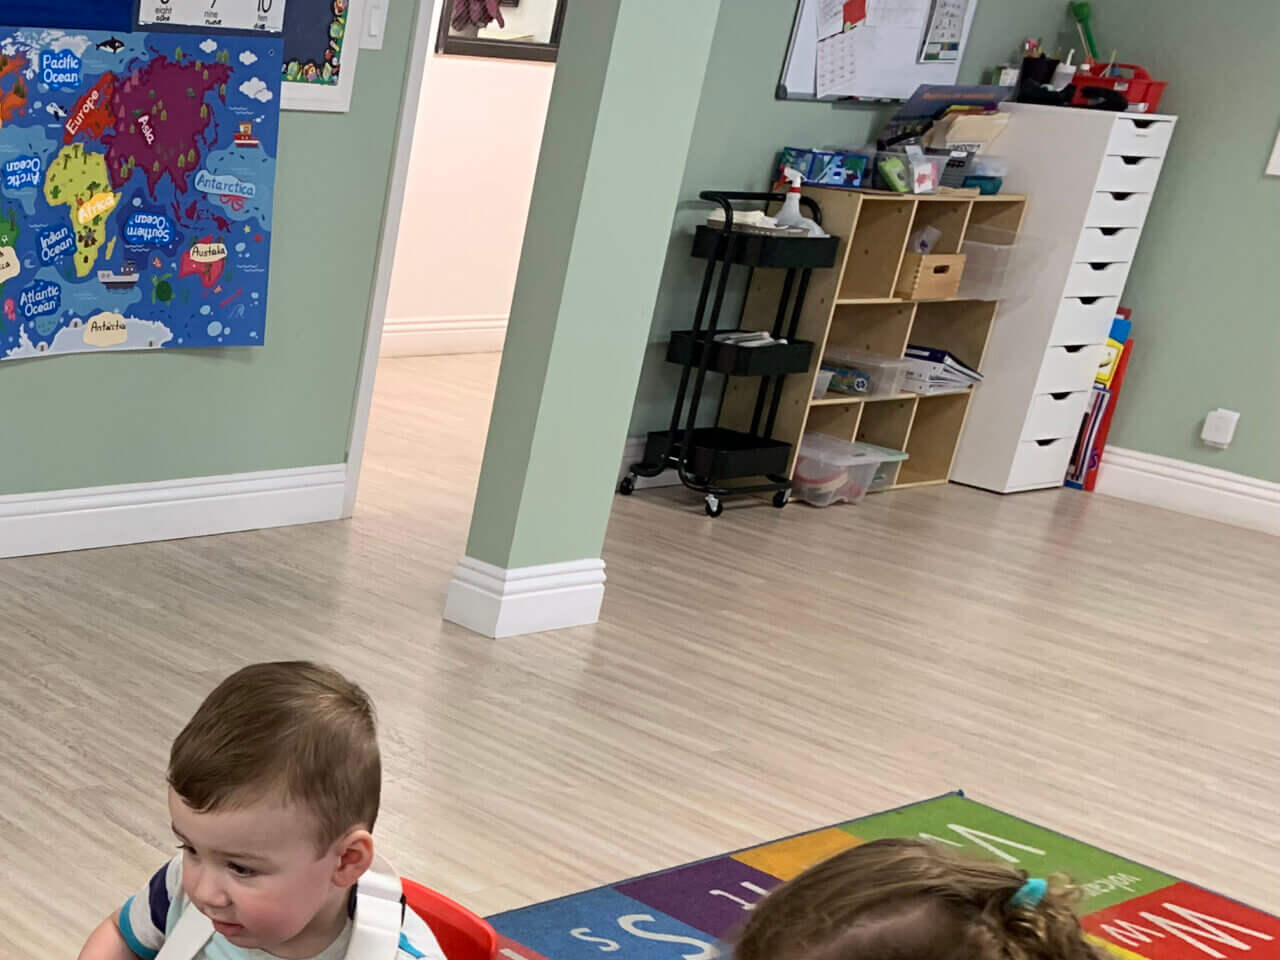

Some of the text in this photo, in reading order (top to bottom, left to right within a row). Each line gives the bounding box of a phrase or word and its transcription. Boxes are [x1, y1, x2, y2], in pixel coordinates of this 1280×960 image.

[42, 54, 79, 70] Pacific
[43, 68, 79, 83] Ocean
[65, 90, 99, 135] Europe
[137, 115, 155, 145] Asia
[6, 158, 41, 173] Ocean
[7, 171, 40, 187] Arctic
[196, 174, 255, 197] Antarctica
[79, 196, 115, 222] Africa
[134, 214, 166, 230] Ocean
[40, 227, 68, 248] Indian
[126, 226, 171, 242] Southern
[41, 238, 73, 261] Ocean
[20, 286, 59, 306] Atlantic
[24, 300, 56, 317] Ocean
